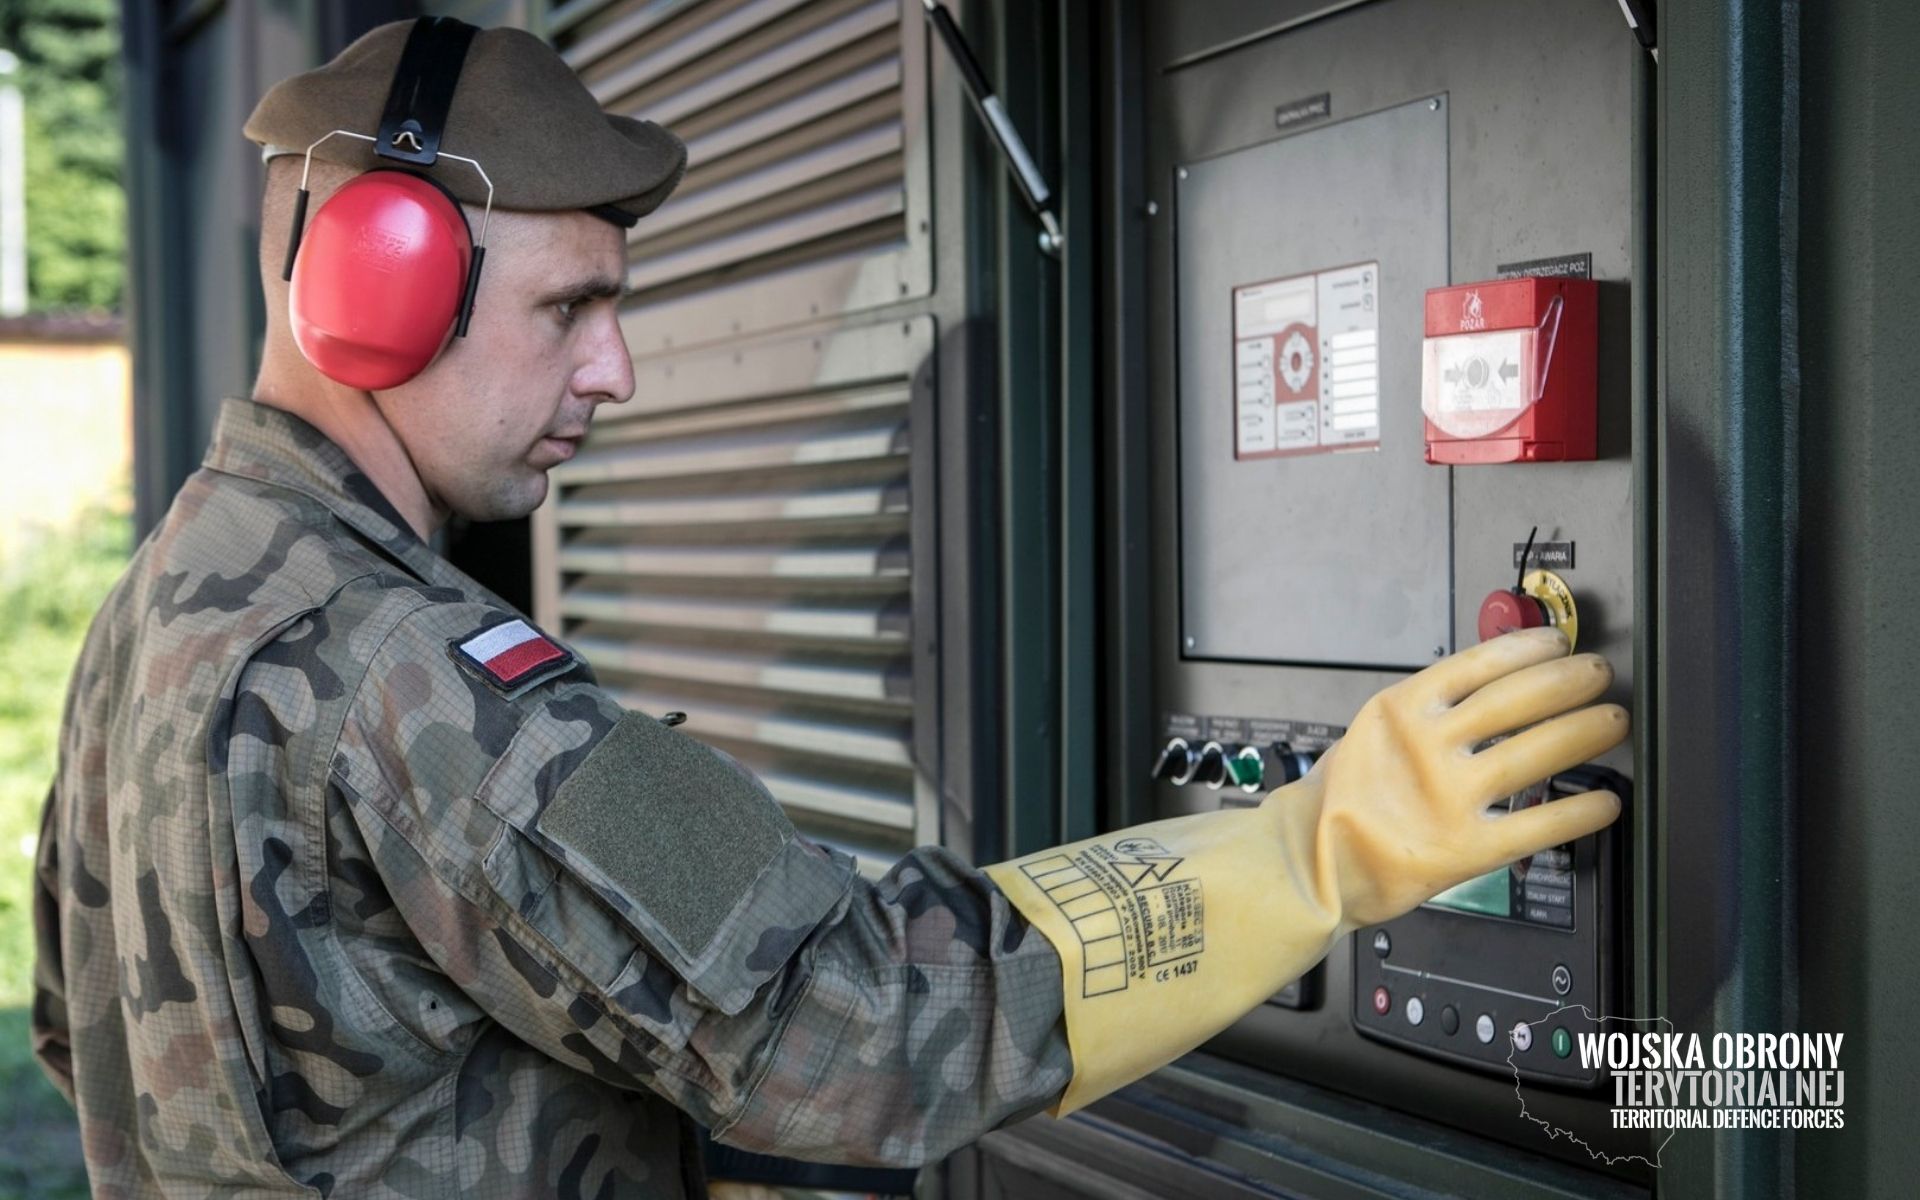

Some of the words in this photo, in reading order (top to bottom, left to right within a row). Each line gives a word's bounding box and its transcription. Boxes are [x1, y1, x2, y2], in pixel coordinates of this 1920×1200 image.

[1540, 551, 1567, 561] AWARIA
[1136, 894, 1154, 937] SECURA
[1173, 960, 1198, 978] 1437
